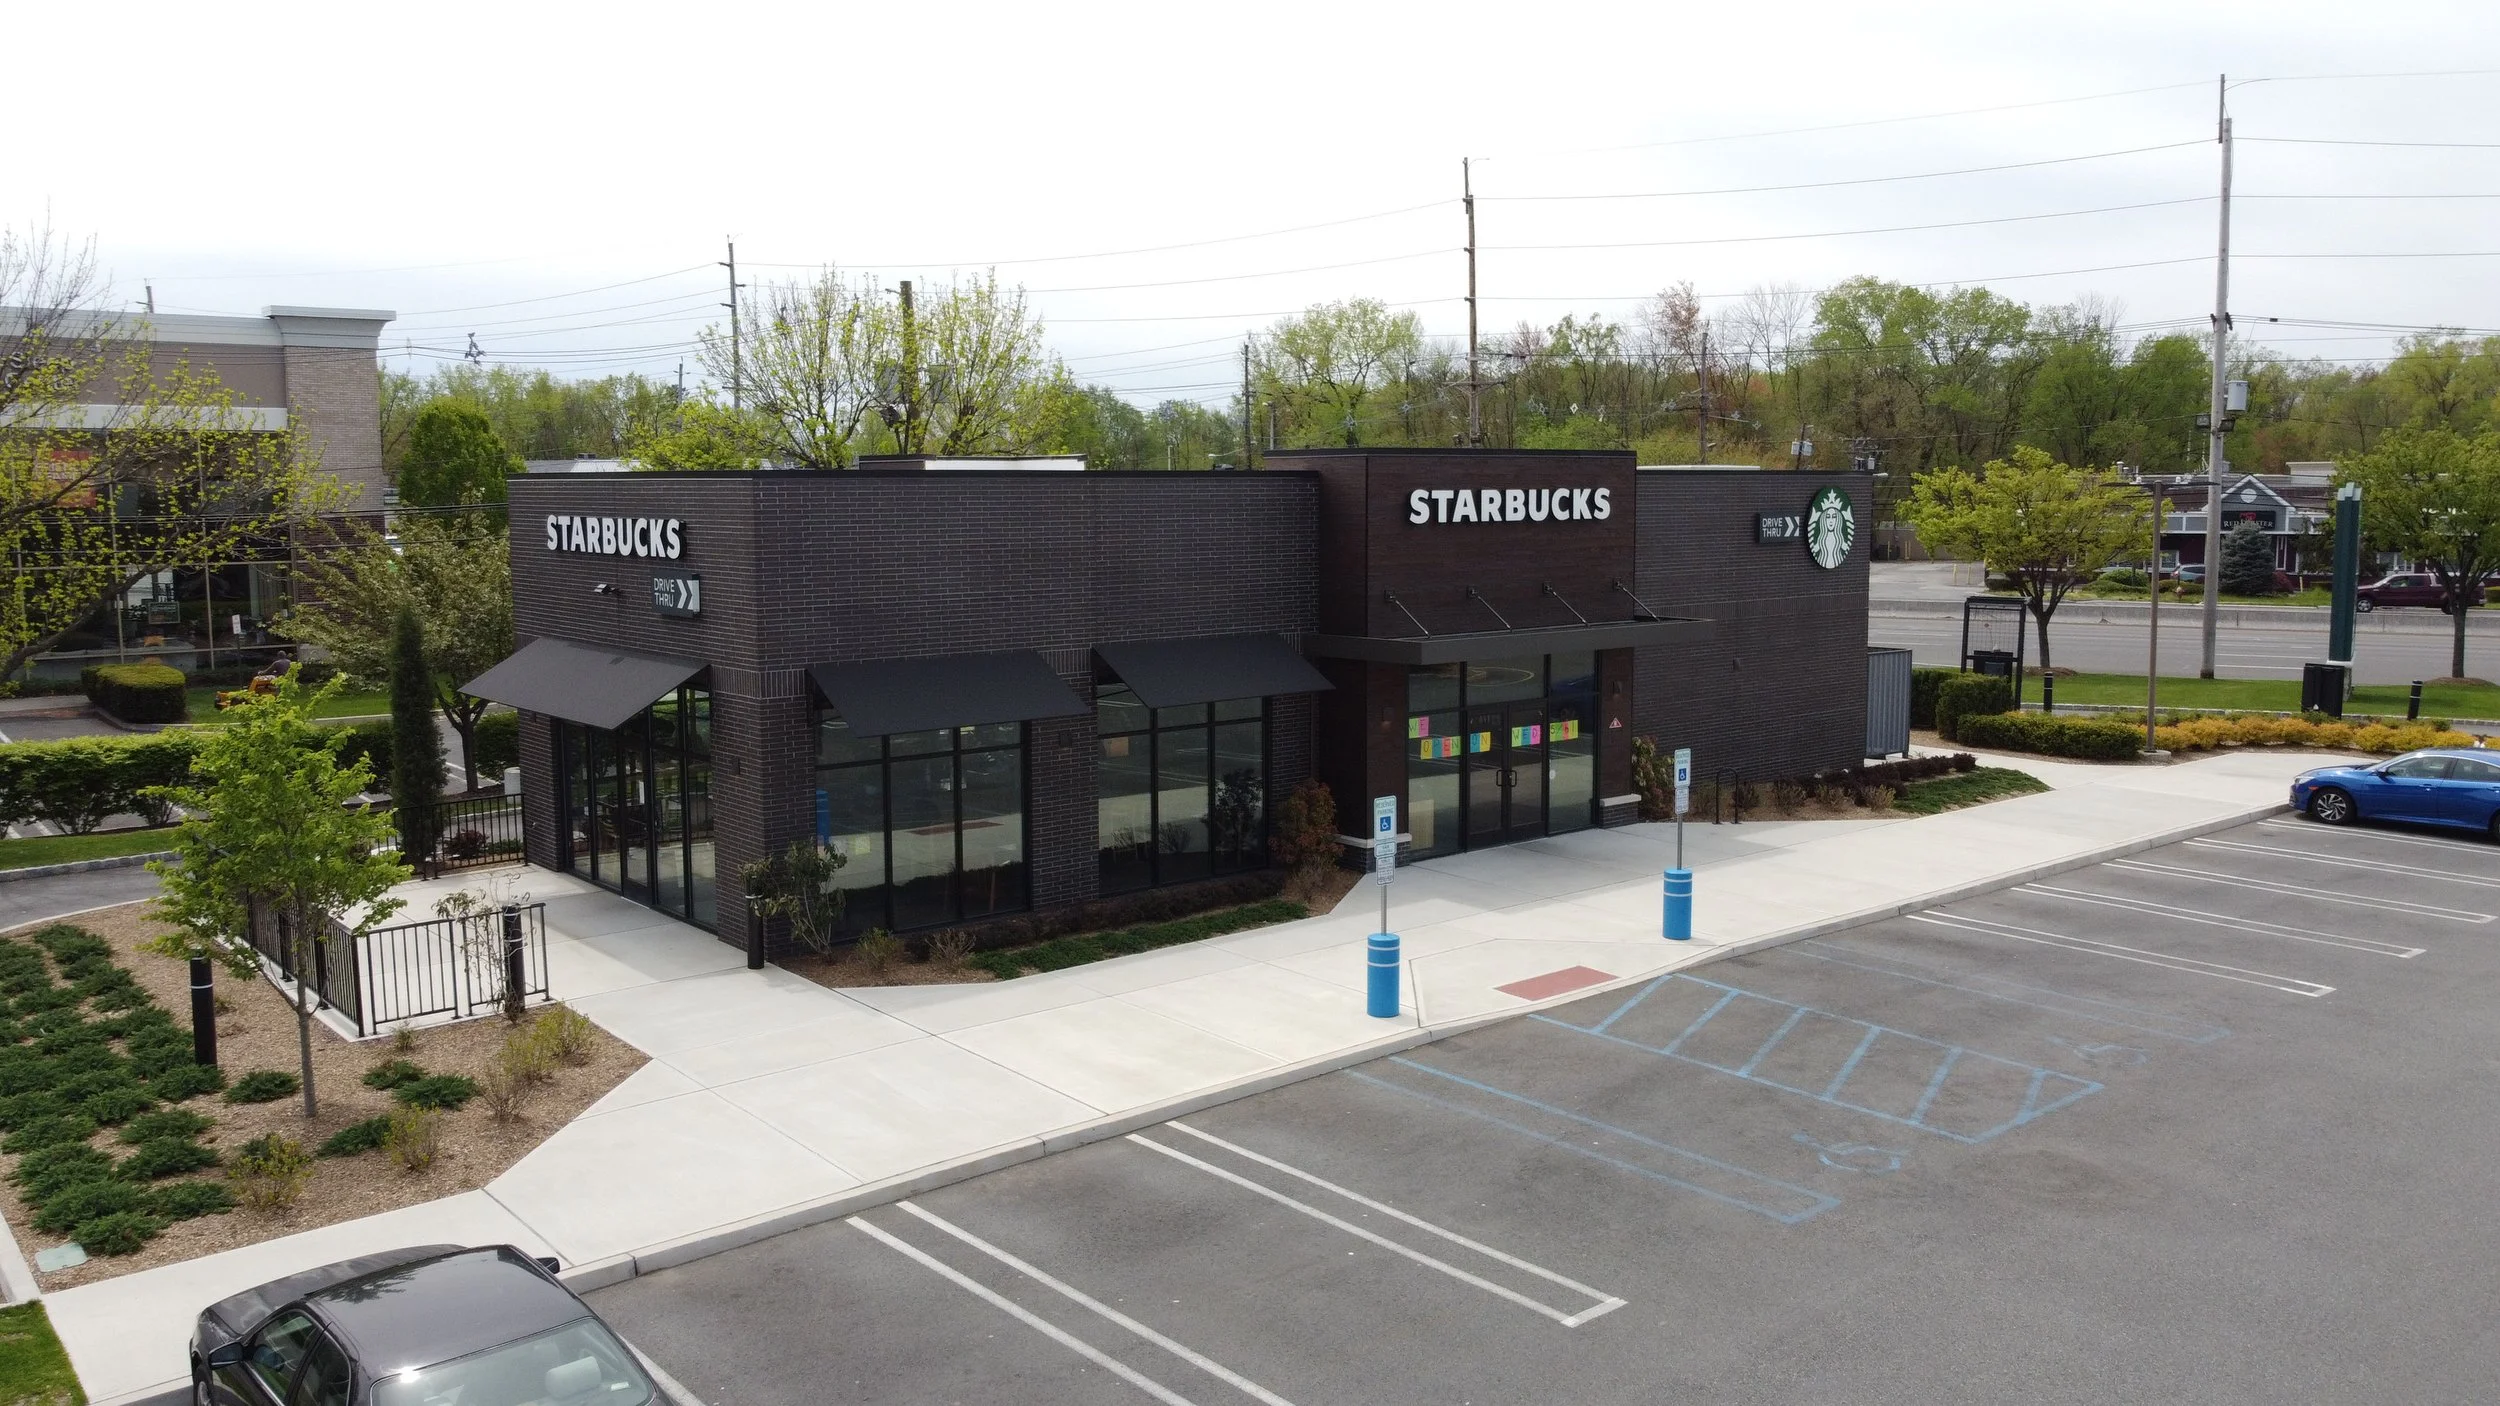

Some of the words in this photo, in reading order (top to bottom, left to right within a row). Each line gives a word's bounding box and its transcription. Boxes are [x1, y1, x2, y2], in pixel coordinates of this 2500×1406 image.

[1409, 488, 1611, 524] STARBUCKS
[1762, 517, 1783, 527] DRIVE
[547, 514, 681, 559] STARBUCKS
[1762, 528, 1782, 537] THRU
[653, 577, 675, 592] DRIVE
[654, 592, 674, 607] THRU
[1409, 719, 1427, 733] WE
[1423, 737, 1460, 753] OPEN
[1472, 731, 1489, 746] ON
[1513, 727, 1539, 741] WED
